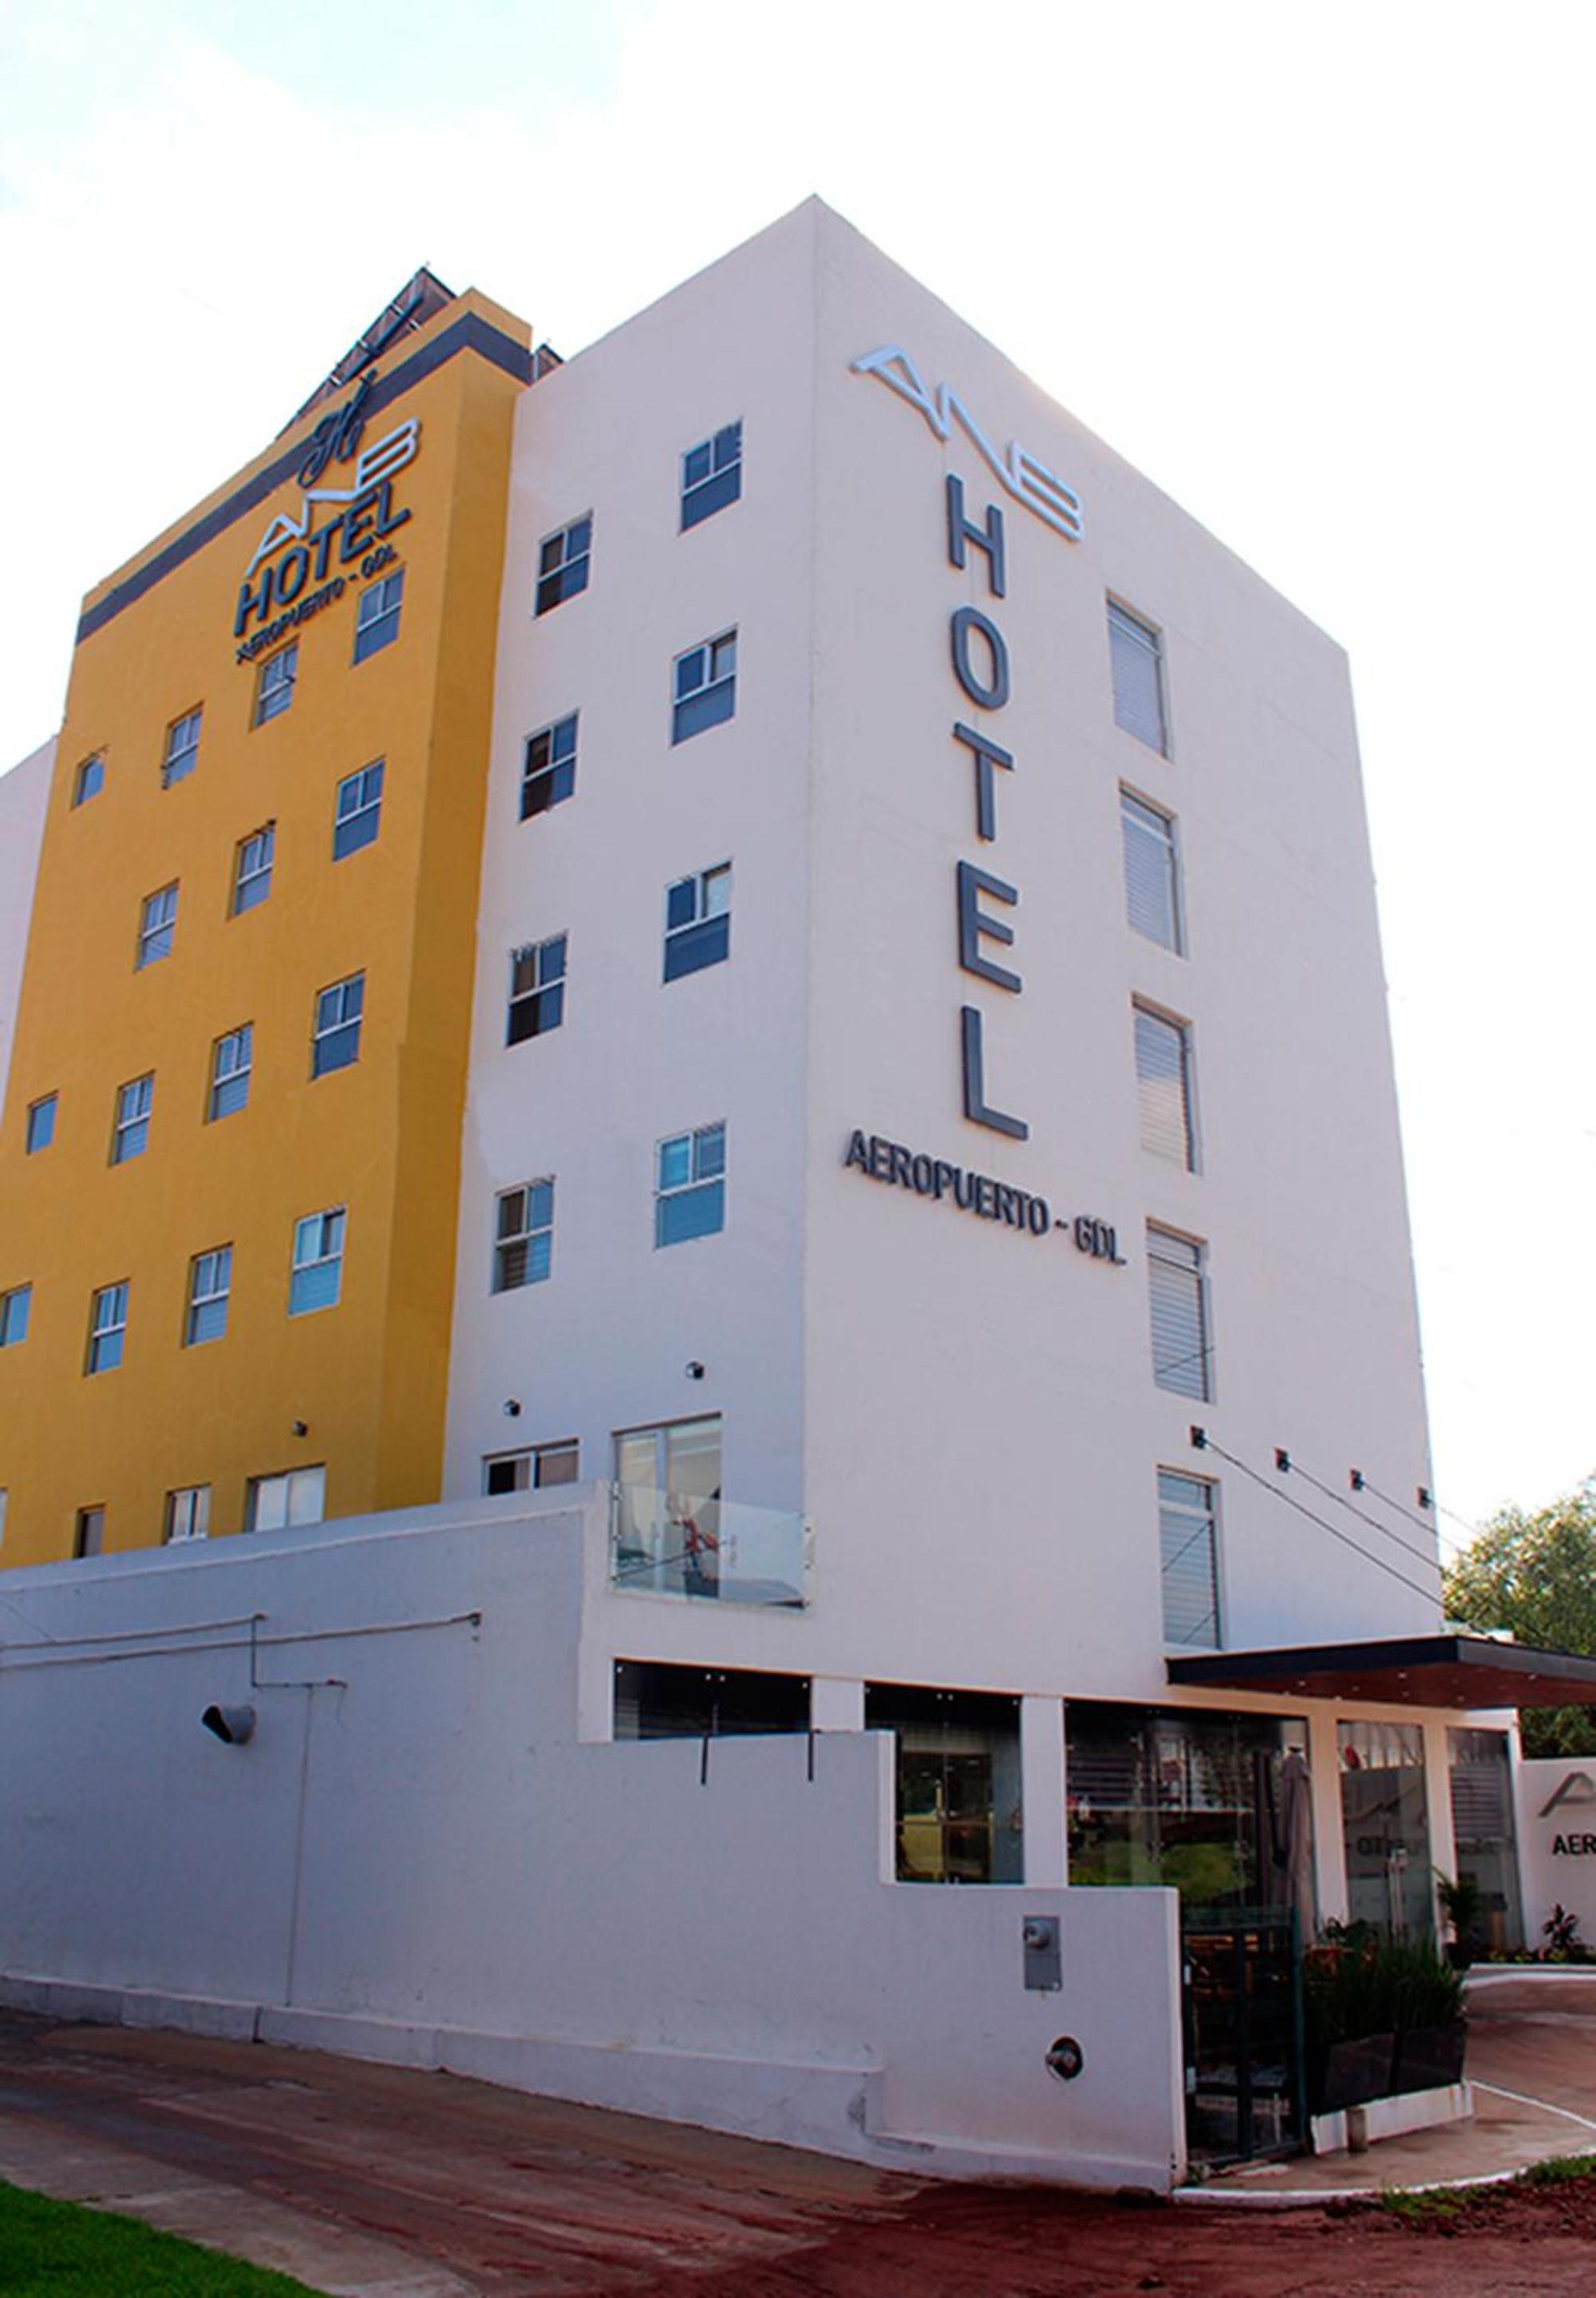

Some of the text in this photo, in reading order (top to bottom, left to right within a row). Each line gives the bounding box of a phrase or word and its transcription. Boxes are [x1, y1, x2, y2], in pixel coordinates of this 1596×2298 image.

[234, 480, 412, 638] HOTEL
[236, 576, 345, 664] AEROPUERTO
[946, 473, 1029, 1141] HOTEL
[844, 1129, 1049, 1236] AEROPUERTO
[1073, 1214, 1128, 1266] GDL
[1551, 1833, 1596, 1857] AER
